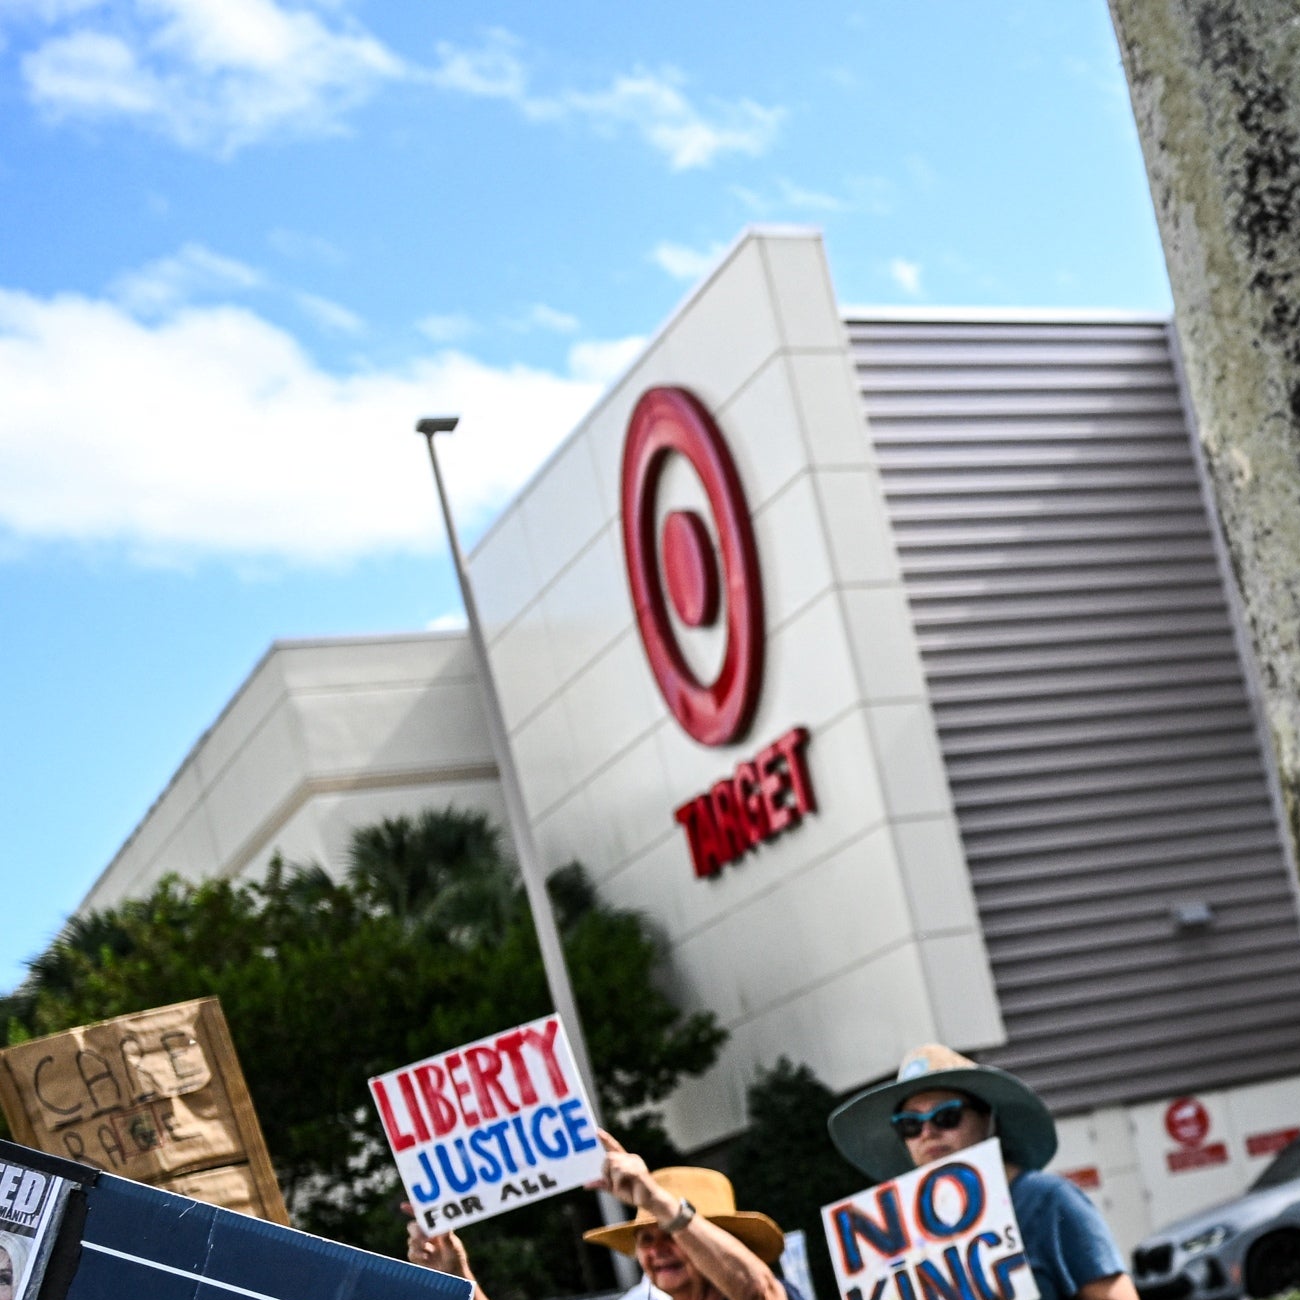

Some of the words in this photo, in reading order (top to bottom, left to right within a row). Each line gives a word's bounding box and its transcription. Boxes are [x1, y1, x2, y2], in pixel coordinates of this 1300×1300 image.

[674, 727, 817, 879] TARGET
[34, 1030, 198, 1115] CARE
[371, 1019, 570, 1153] LIBERTY
[0, 1163, 47, 1215] ED
[411, 1097, 598, 1204] JUSTICE
[0, 1206, 37, 1226] MANITY
[423, 1195, 485, 1230] FOR
[499, 1173, 558, 1202] ALL
[830, 1161, 987, 1278] NO
